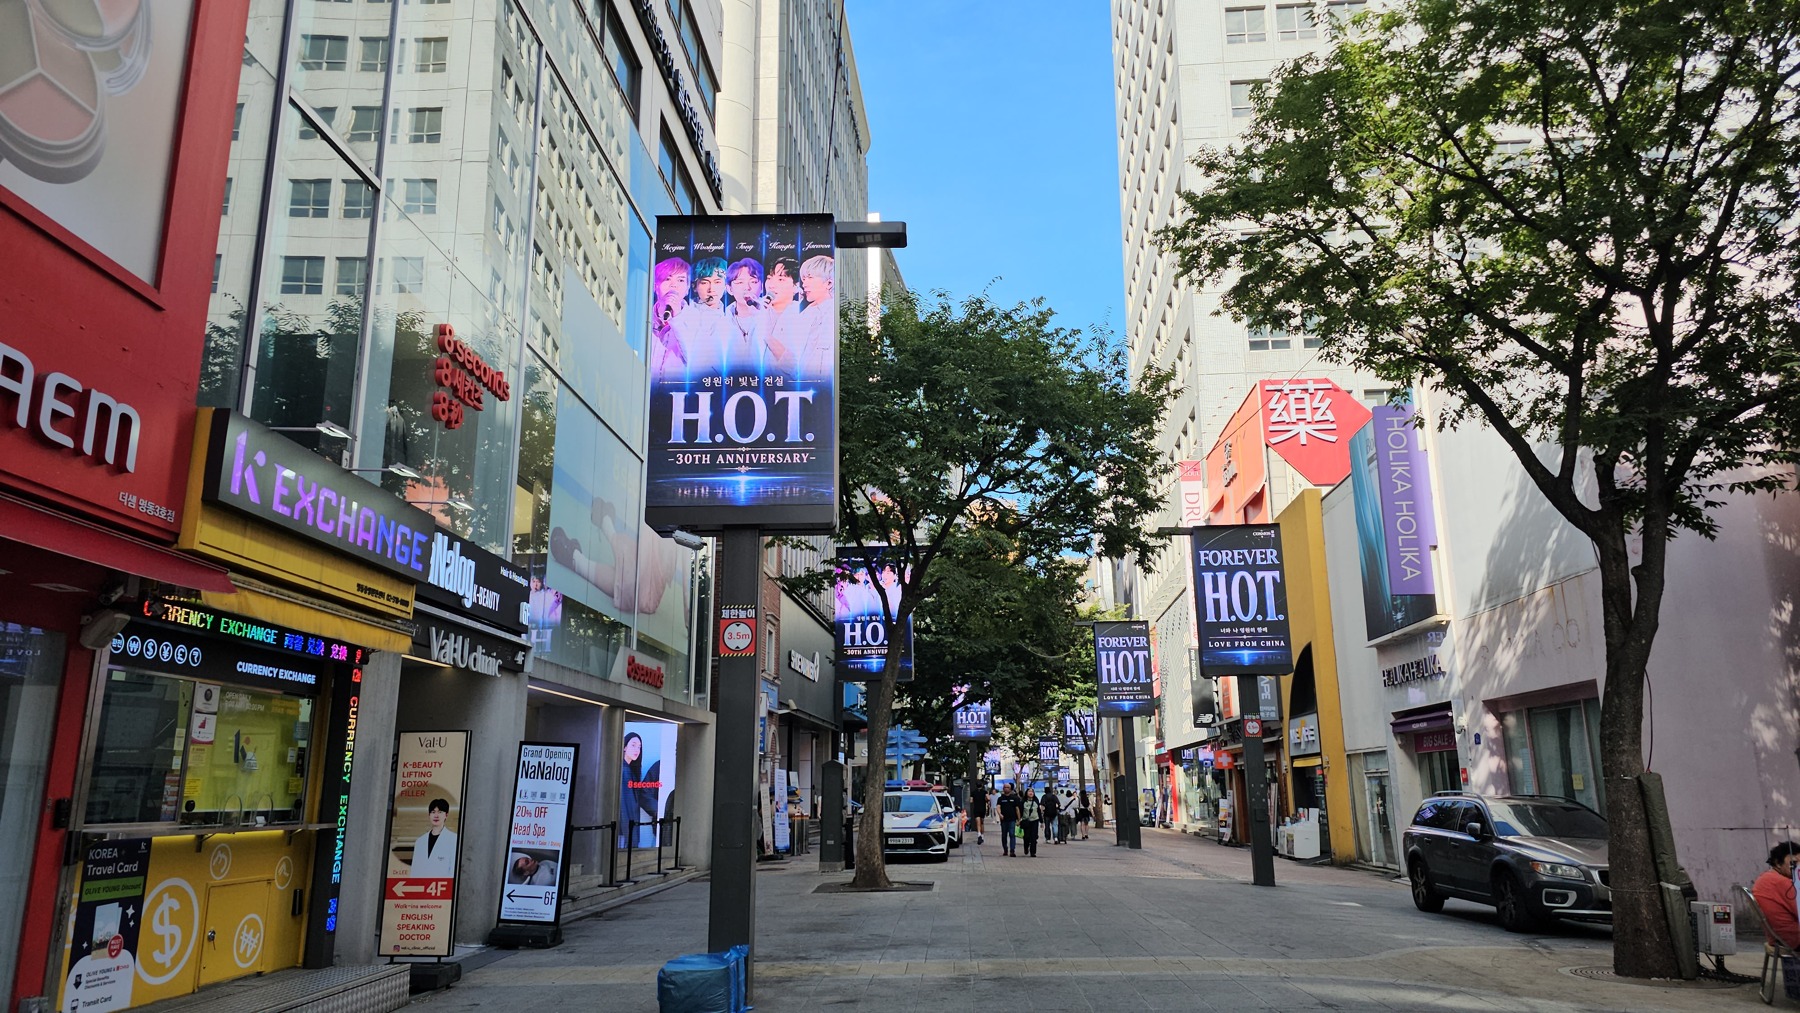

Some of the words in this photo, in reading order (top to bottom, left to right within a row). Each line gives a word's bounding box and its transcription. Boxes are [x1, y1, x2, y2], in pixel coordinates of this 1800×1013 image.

[702, 377, 733, 387] 영원히
[738, 376, 759, 387] 빛날
[764, 376, 784, 387] 전설
[667, 390, 815, 444] H.O.T.
[1264, 379, 1339, 445] 藥
[1385, 416, 1413, 495] HOLIKA
[138, 498, 175, 523] 명동3호점
[272, 462, 429, 573] EXCHANGE
[1394, 501, 1422, 582] HOLIKA
[1199, 549, 1280, 566] FOREVER
[1202, 571, 1285, 622] H.O.T.
[143, 600, 215, 630] CRRENCY
[219, 617, 279, 646] EXCHANGE
[727, 631, 750, 640] 3.5m
[843, 621, 889, 646] H.O.
[1098, 636, 1148, 648] FOREVER
[236, 661, 278, 678] CURRENCY
[278, 667, 317, 685] EXCHANGE
[1099, 650, 1151, 684] H.O.T.
[956, 711, 988, 724] H.O.T.
[342, 696, 358, 783] CURRENCY
[418, 736, 448, 748] Val:U
[523, 747, 543, 758] Grand
[545, 748, 572, 762] Opening
[403, 761, 443, 769] K-BEAUTY
[520, 760, 570, 785] NaNalog
[515, 805, 533, 818] 20%
[534, 806, 549, 819] OFF
[513, 822, 531, 836] Head
[532, 823, 546, 839] Spa
[331, 794, 348, 885] EXCHANGE
[88, 848, 118, 860] KOREA
[87, 863, 116, 876] Travel
[116, 861, 139, 874] Card
[84, 886, 102, 896] OLIVE
[102, 884, 120, 894] YOUNG
[426, 881, 448, 897] 4F
[543, 891, 556, 906] 6F
[401, 913, 433, 921] ENGLISH
[396, 923, 436, 931] SPEAKING
[399, 933, 431, 941] DOCTOR
[99, 995, 113, 1004] Card
